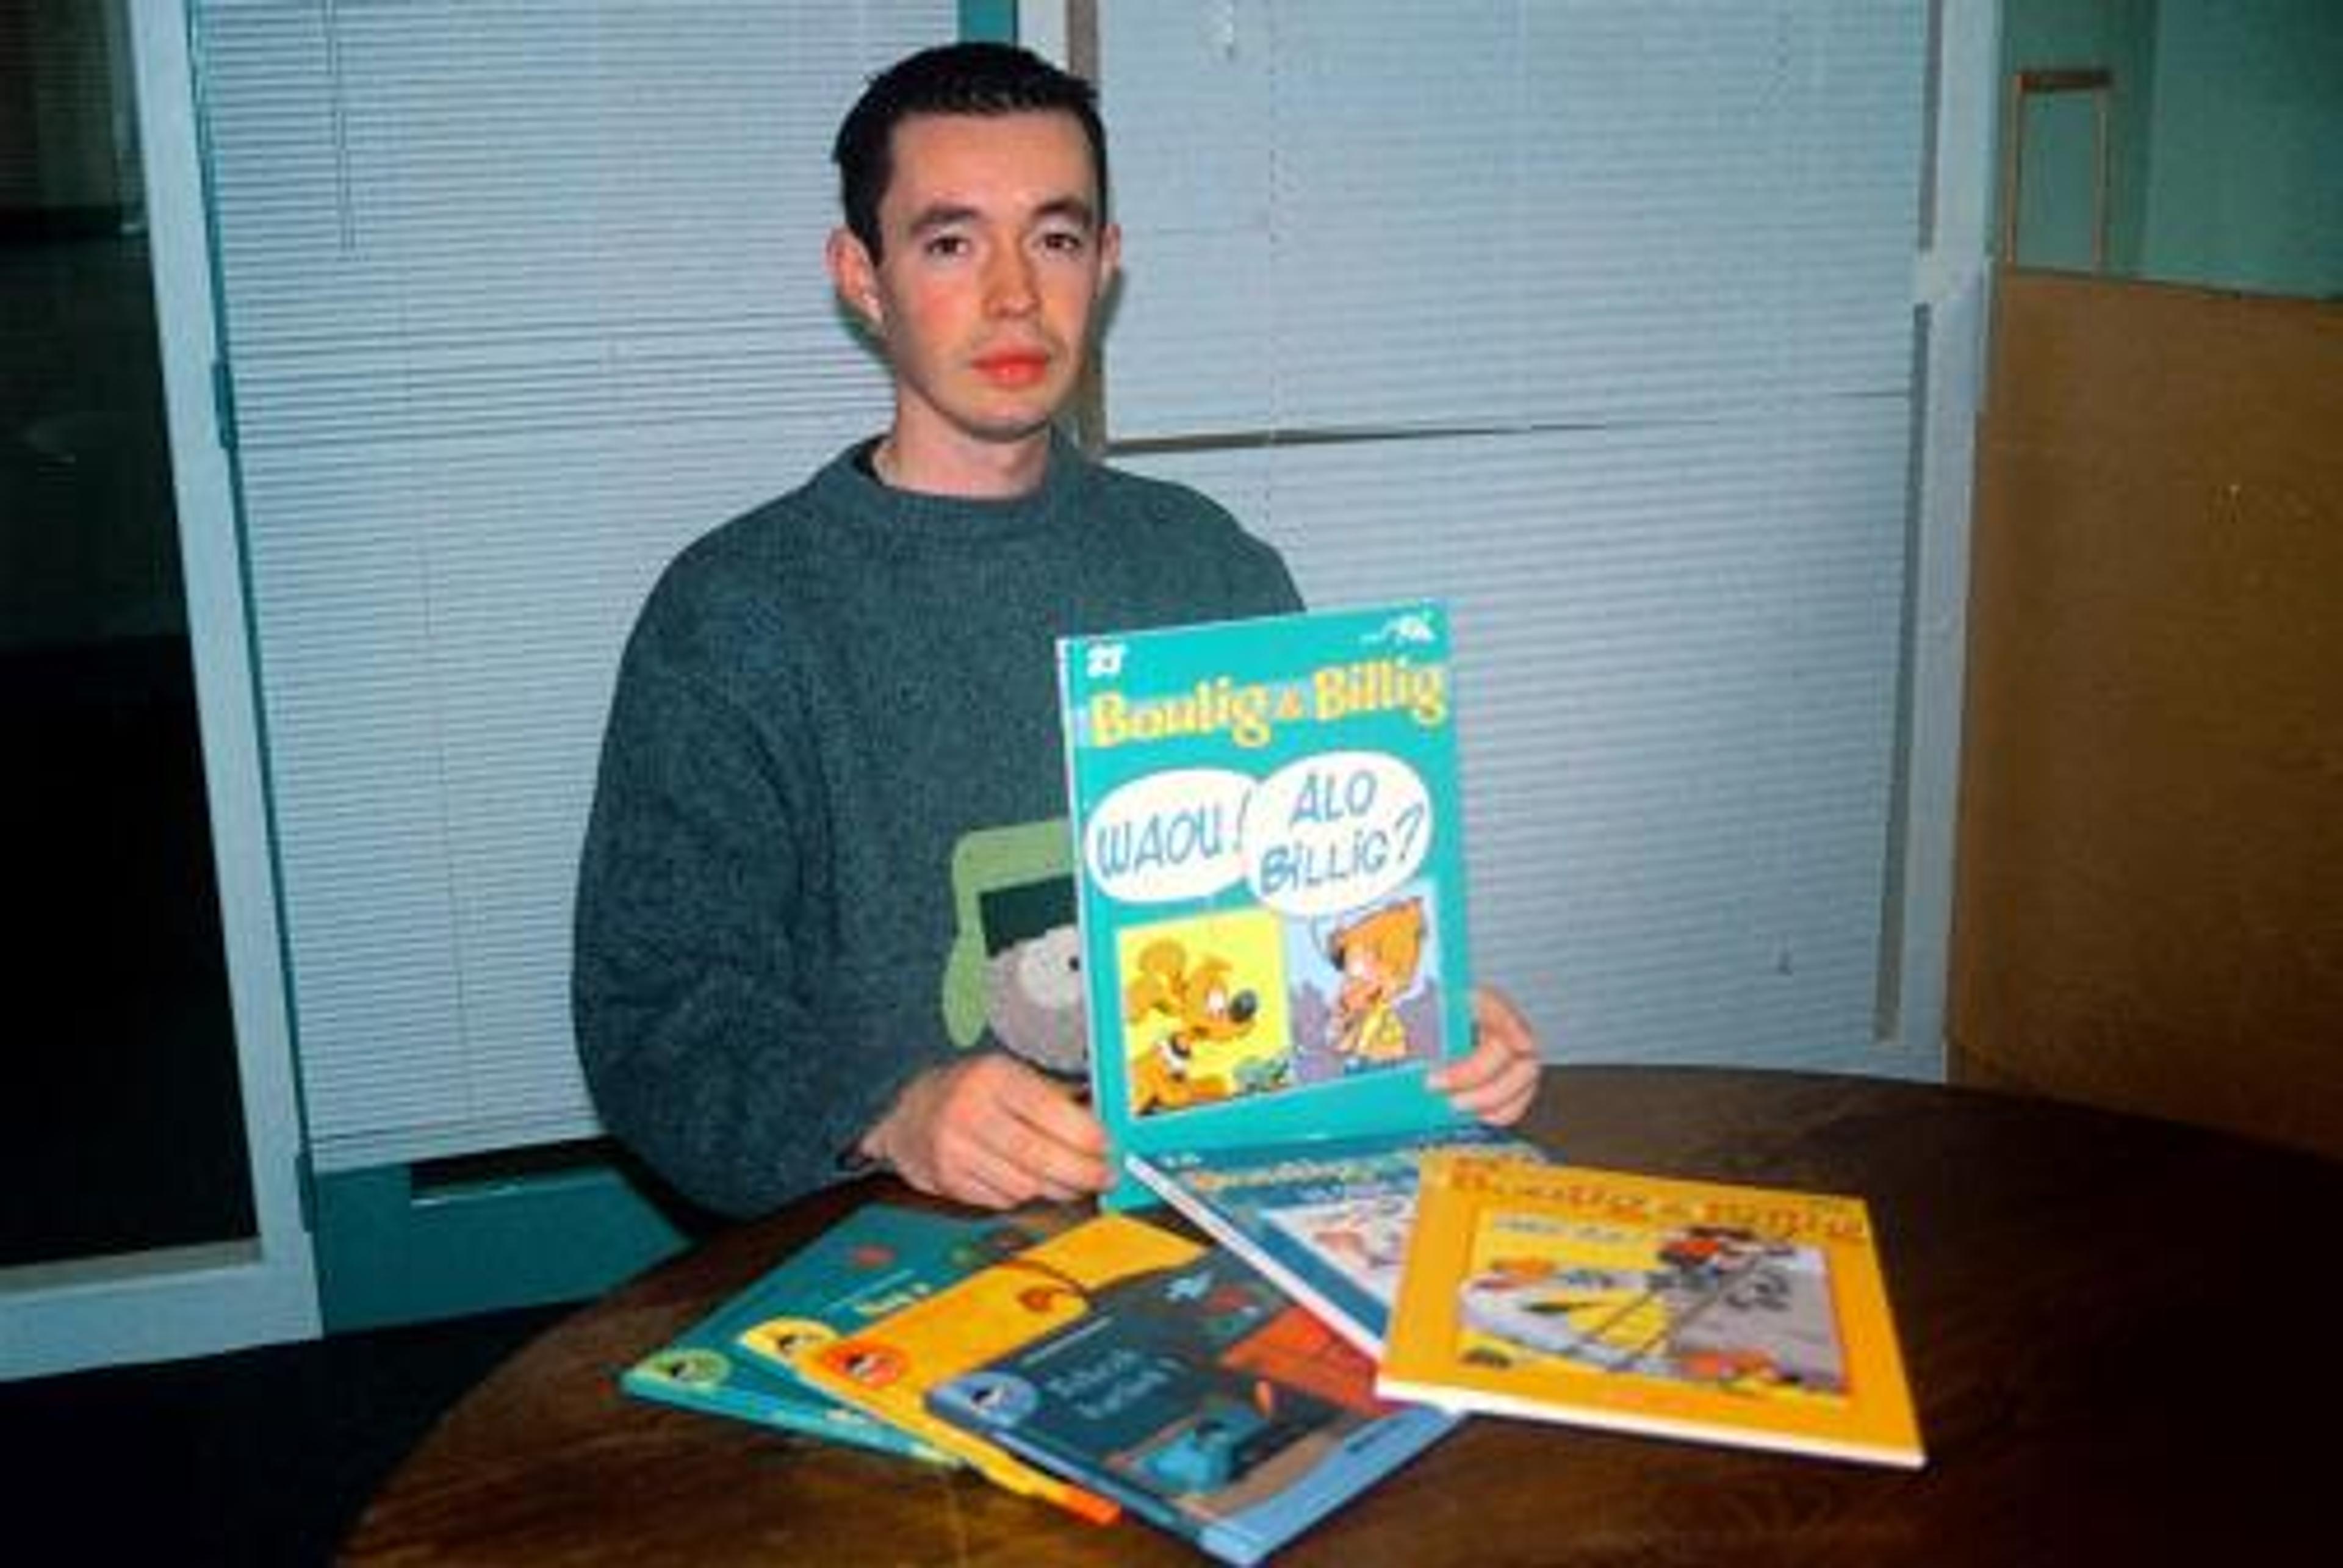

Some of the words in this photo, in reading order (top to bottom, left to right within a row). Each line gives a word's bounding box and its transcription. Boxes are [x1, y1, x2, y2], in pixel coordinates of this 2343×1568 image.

[1091, 675, 1272, 748] Boulig
[1314, 655, 1448, 726] Billig
[1289, 770, 1379, 827] ALO
